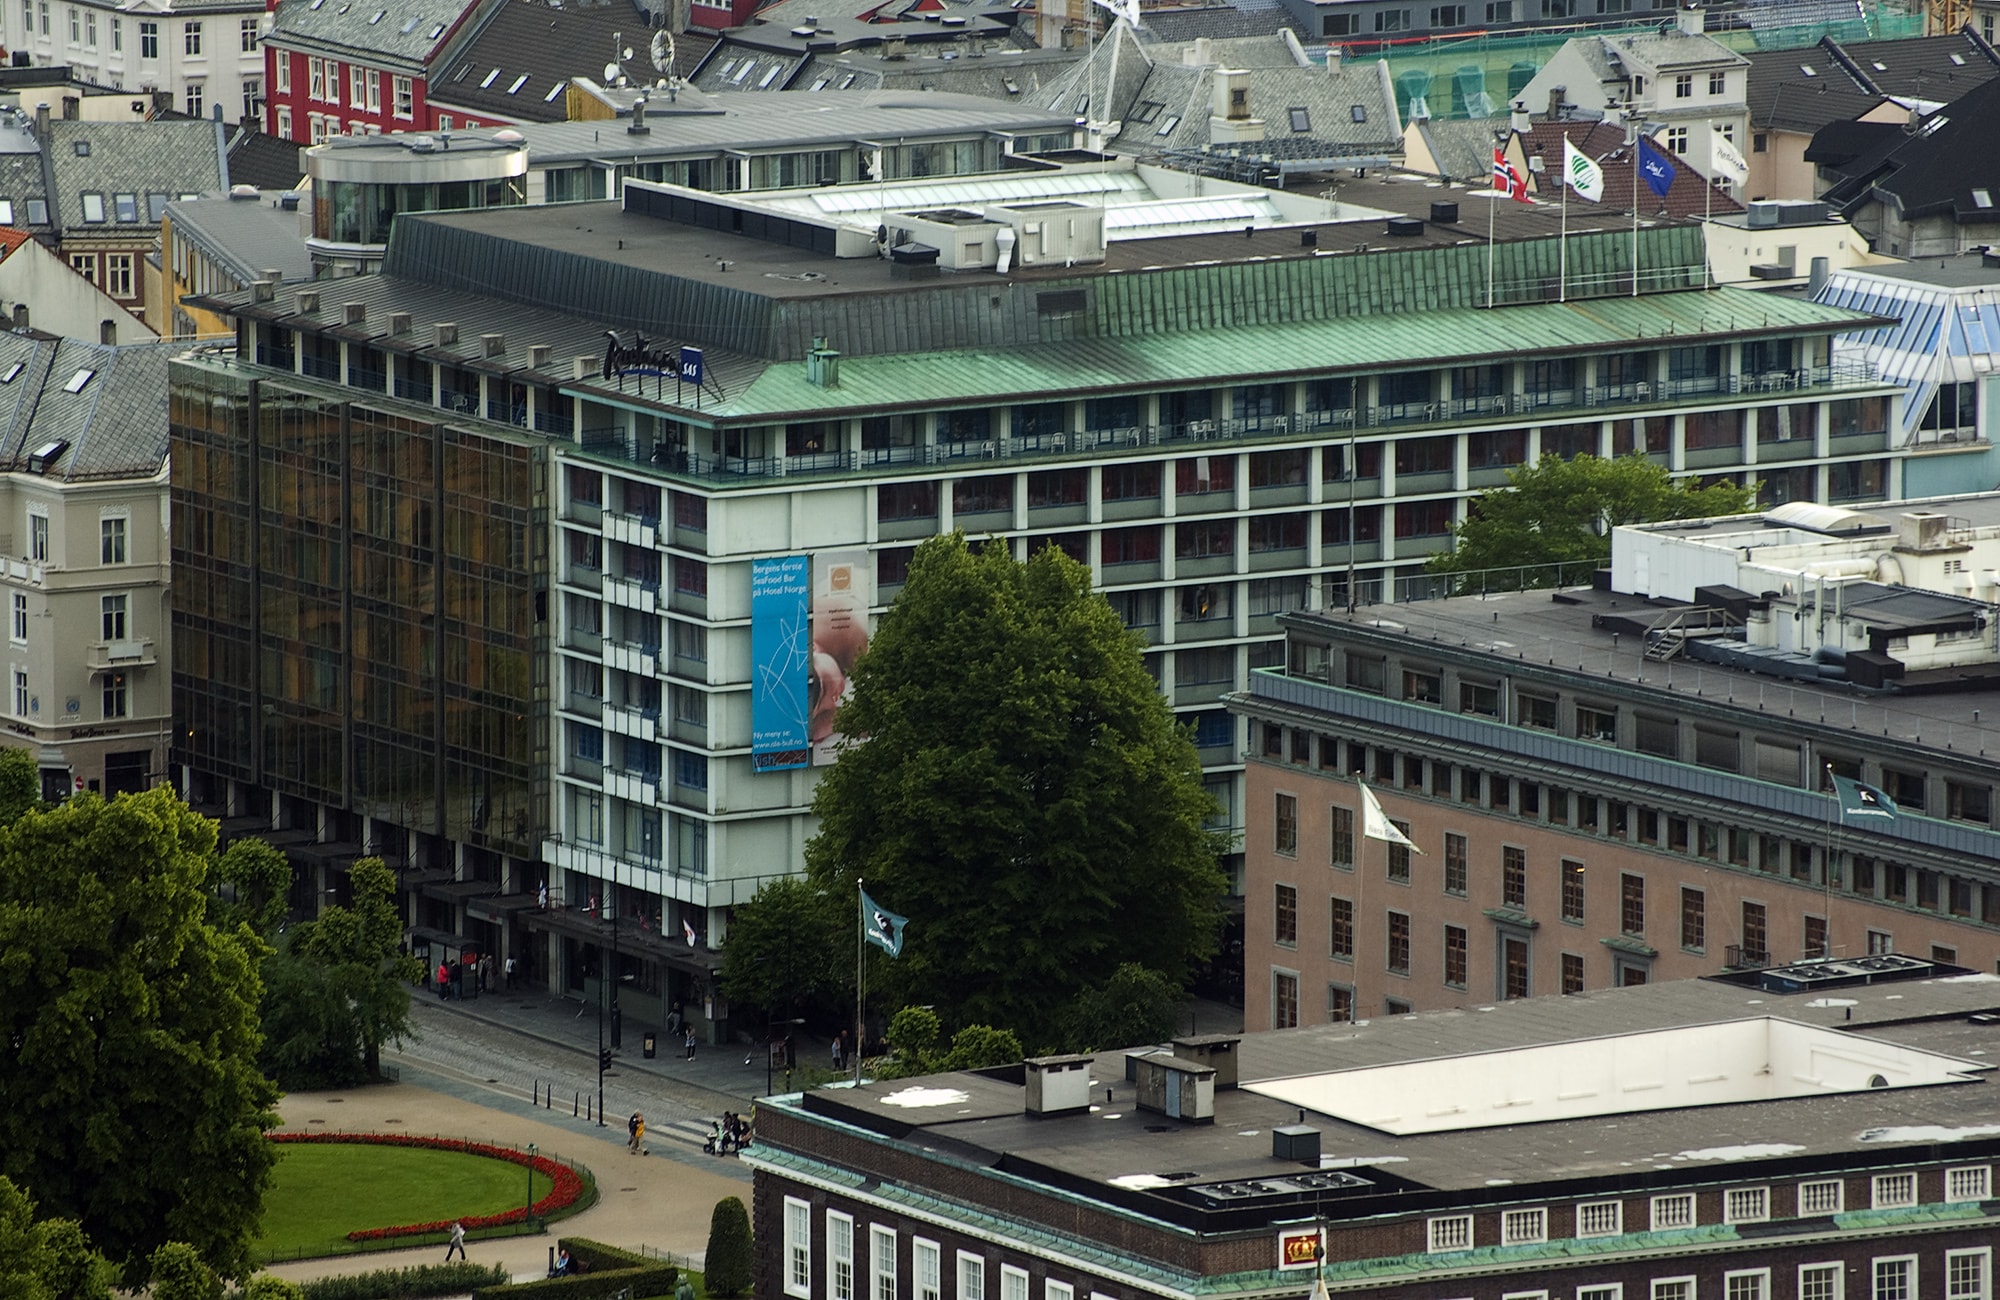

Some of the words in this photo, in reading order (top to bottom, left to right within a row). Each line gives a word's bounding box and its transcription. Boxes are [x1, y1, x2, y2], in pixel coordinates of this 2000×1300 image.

[682, 362, 698, 377] SAS
[753, 564, 780, 575] Bergens
[753, 574, 783, 585] SeaFood
[783, 573, 797, 583] Bar
[763, 585, 783, 596] Hotel
[784, 585, 807, 595] Norge
